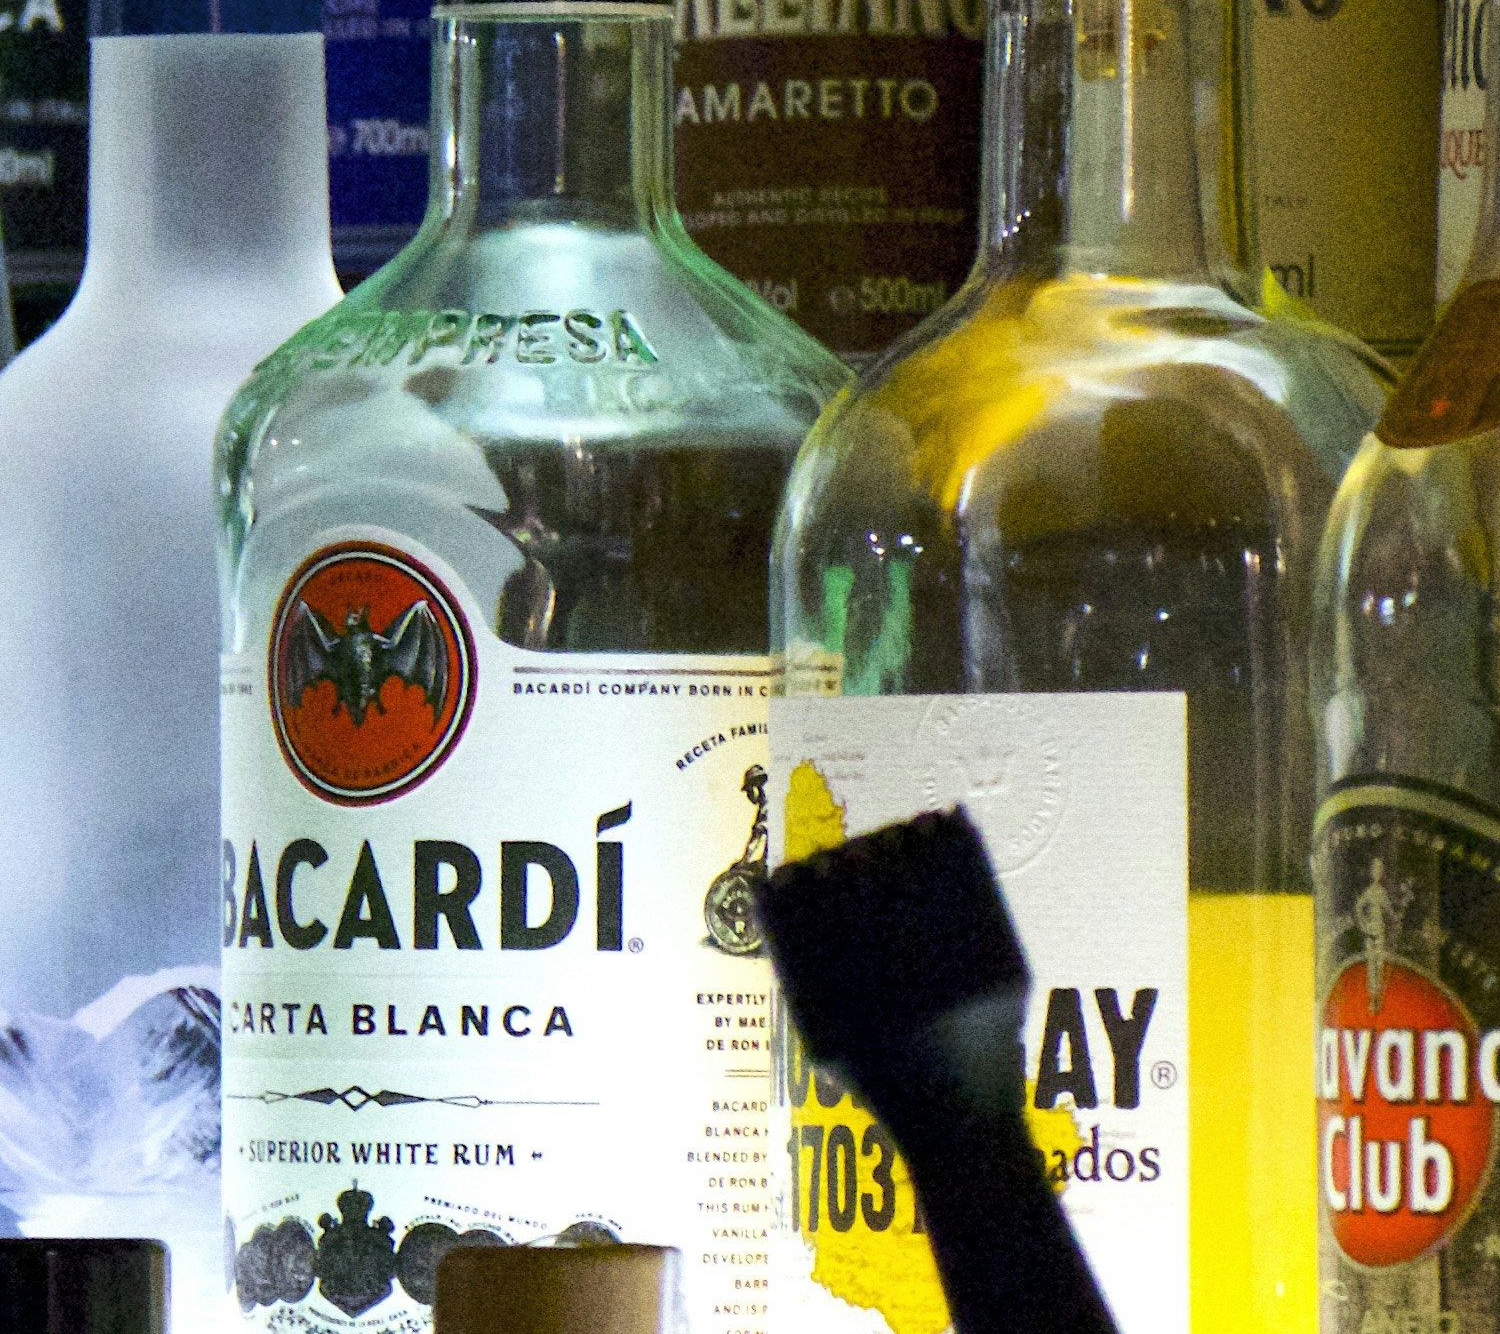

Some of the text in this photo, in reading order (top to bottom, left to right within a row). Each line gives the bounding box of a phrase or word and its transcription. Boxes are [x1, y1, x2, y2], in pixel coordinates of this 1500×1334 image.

[675, 78, 940, 124] AMARETTO
[352, 119, 432, 156] 700m
[597, 682, 683, 698] COMPANY
[688, 683, 732, 698] BORN
[737, 683, 756, 698] IN
[674, 722, 769, 772] RECETA FAMIL
[696, 993, 767, 1006] EXPERTLY
[230, 1001, 575, 1038] CARTA BLANCA
[715, 1016, 732, 1028] BY
[706, 1039, 760, 1052] DE RON
[1033, 987, 1160, 1110] AY
[711, 1100, 768, 1112] BACARD
[705, 1126, 760, 1137] BLANCA
[247, 1139, 515, 1166] SUPERIOR WHITE RUM
[687, 1151, 749, 1163] BLENDED
[1047, 1125, 1162, 1182] ados
[1324, 1114, 1455, 1214] Club
[708, 1177, 757, 1189] DE RON
[788, 1124, 897, 1233] 1703
[697, 1202, 760, 1213] THIS RUM
[711, 1228, 768, 1239] VANILLA
[702, 1253, 769, 1265] DEVELOPE
[734, 1279, 769, 1289] BARR
[714, 1304, 757, 1315] AND IS
